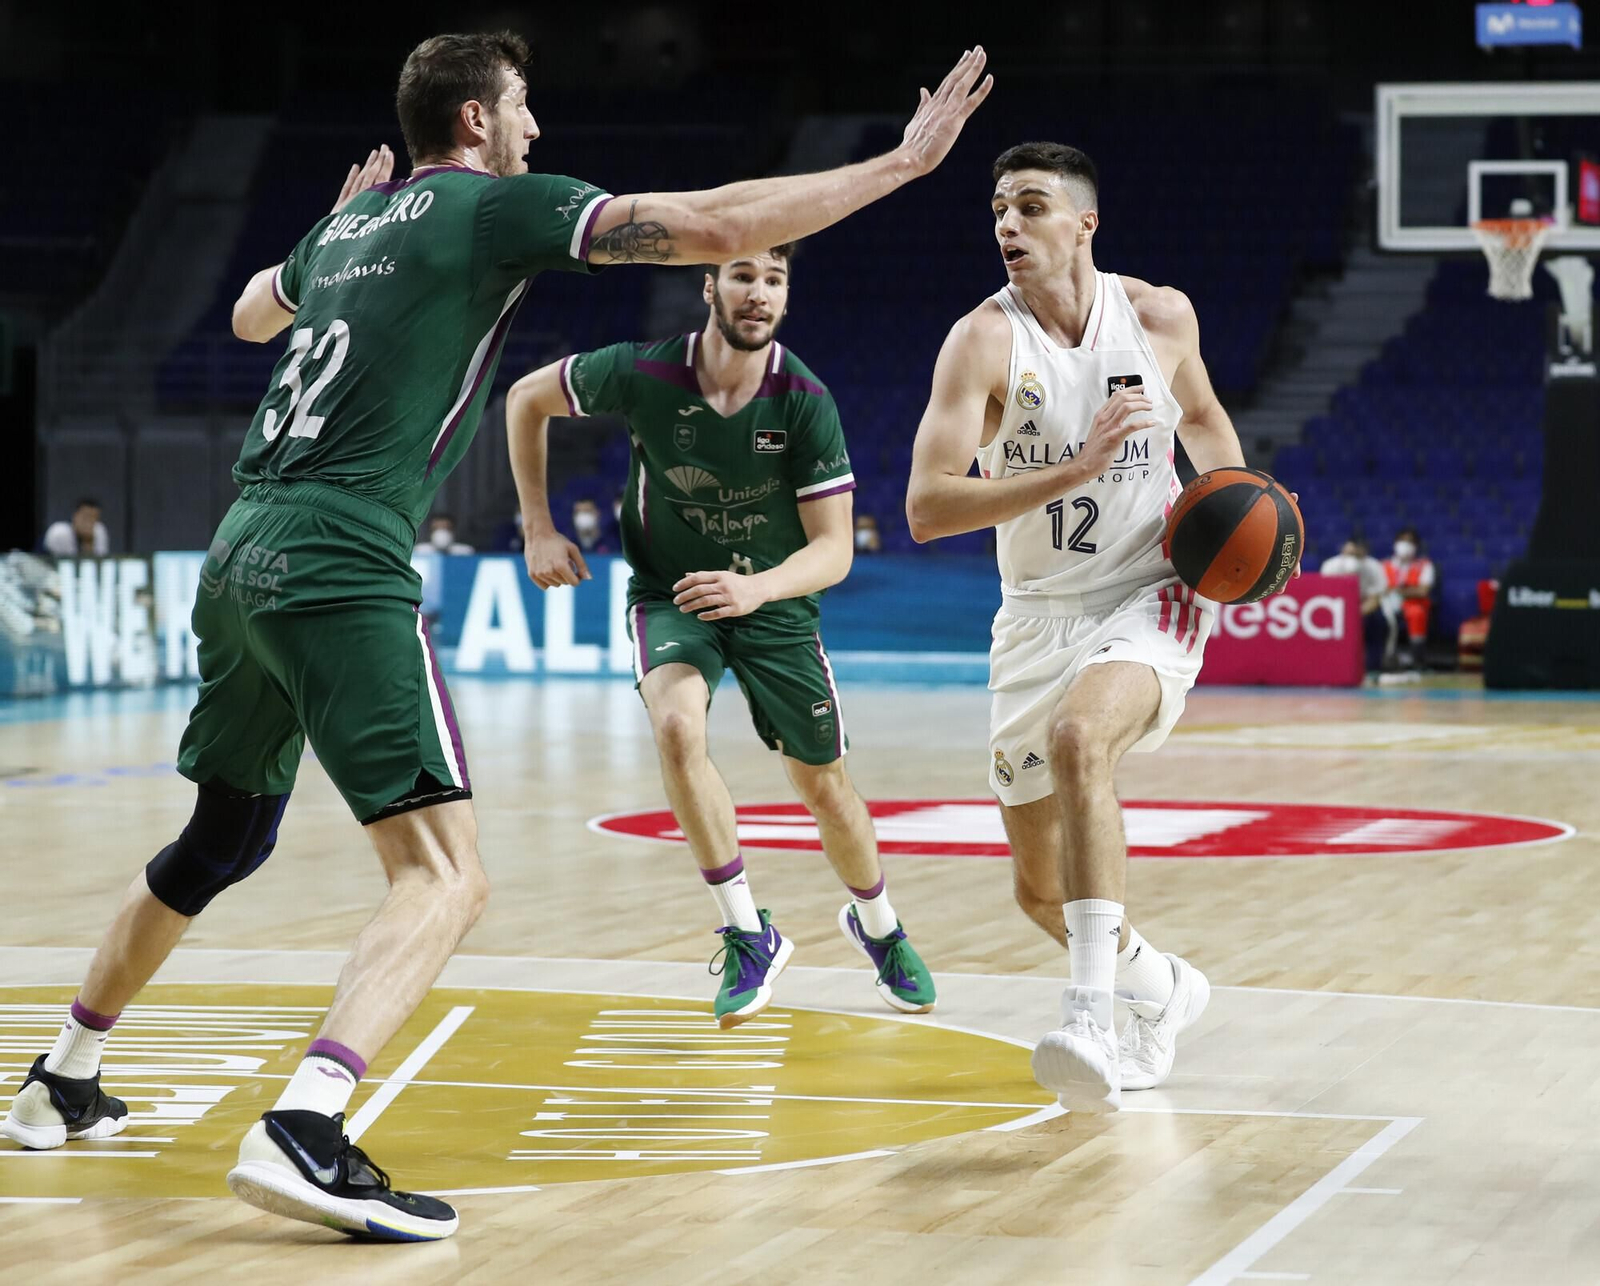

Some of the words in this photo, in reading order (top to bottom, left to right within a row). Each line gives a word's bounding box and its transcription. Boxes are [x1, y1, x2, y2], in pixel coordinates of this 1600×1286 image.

[262, 319, 350, 442] 32
[1016, 429, 1041, 437] adidas
[1003, 437, 1149, 465] PALLAUM
[1086, 470, 1149, 483] ROUP
[718, 478, 781, 502] Unicaja
[1046, 496, 1099, 554] 12
[247, 569, 282, 593] SOL
[57, 558, 149, 687] WE
[1212, 595, 1346, 641] esa
[1021, 759, 1045, 770] adidas
